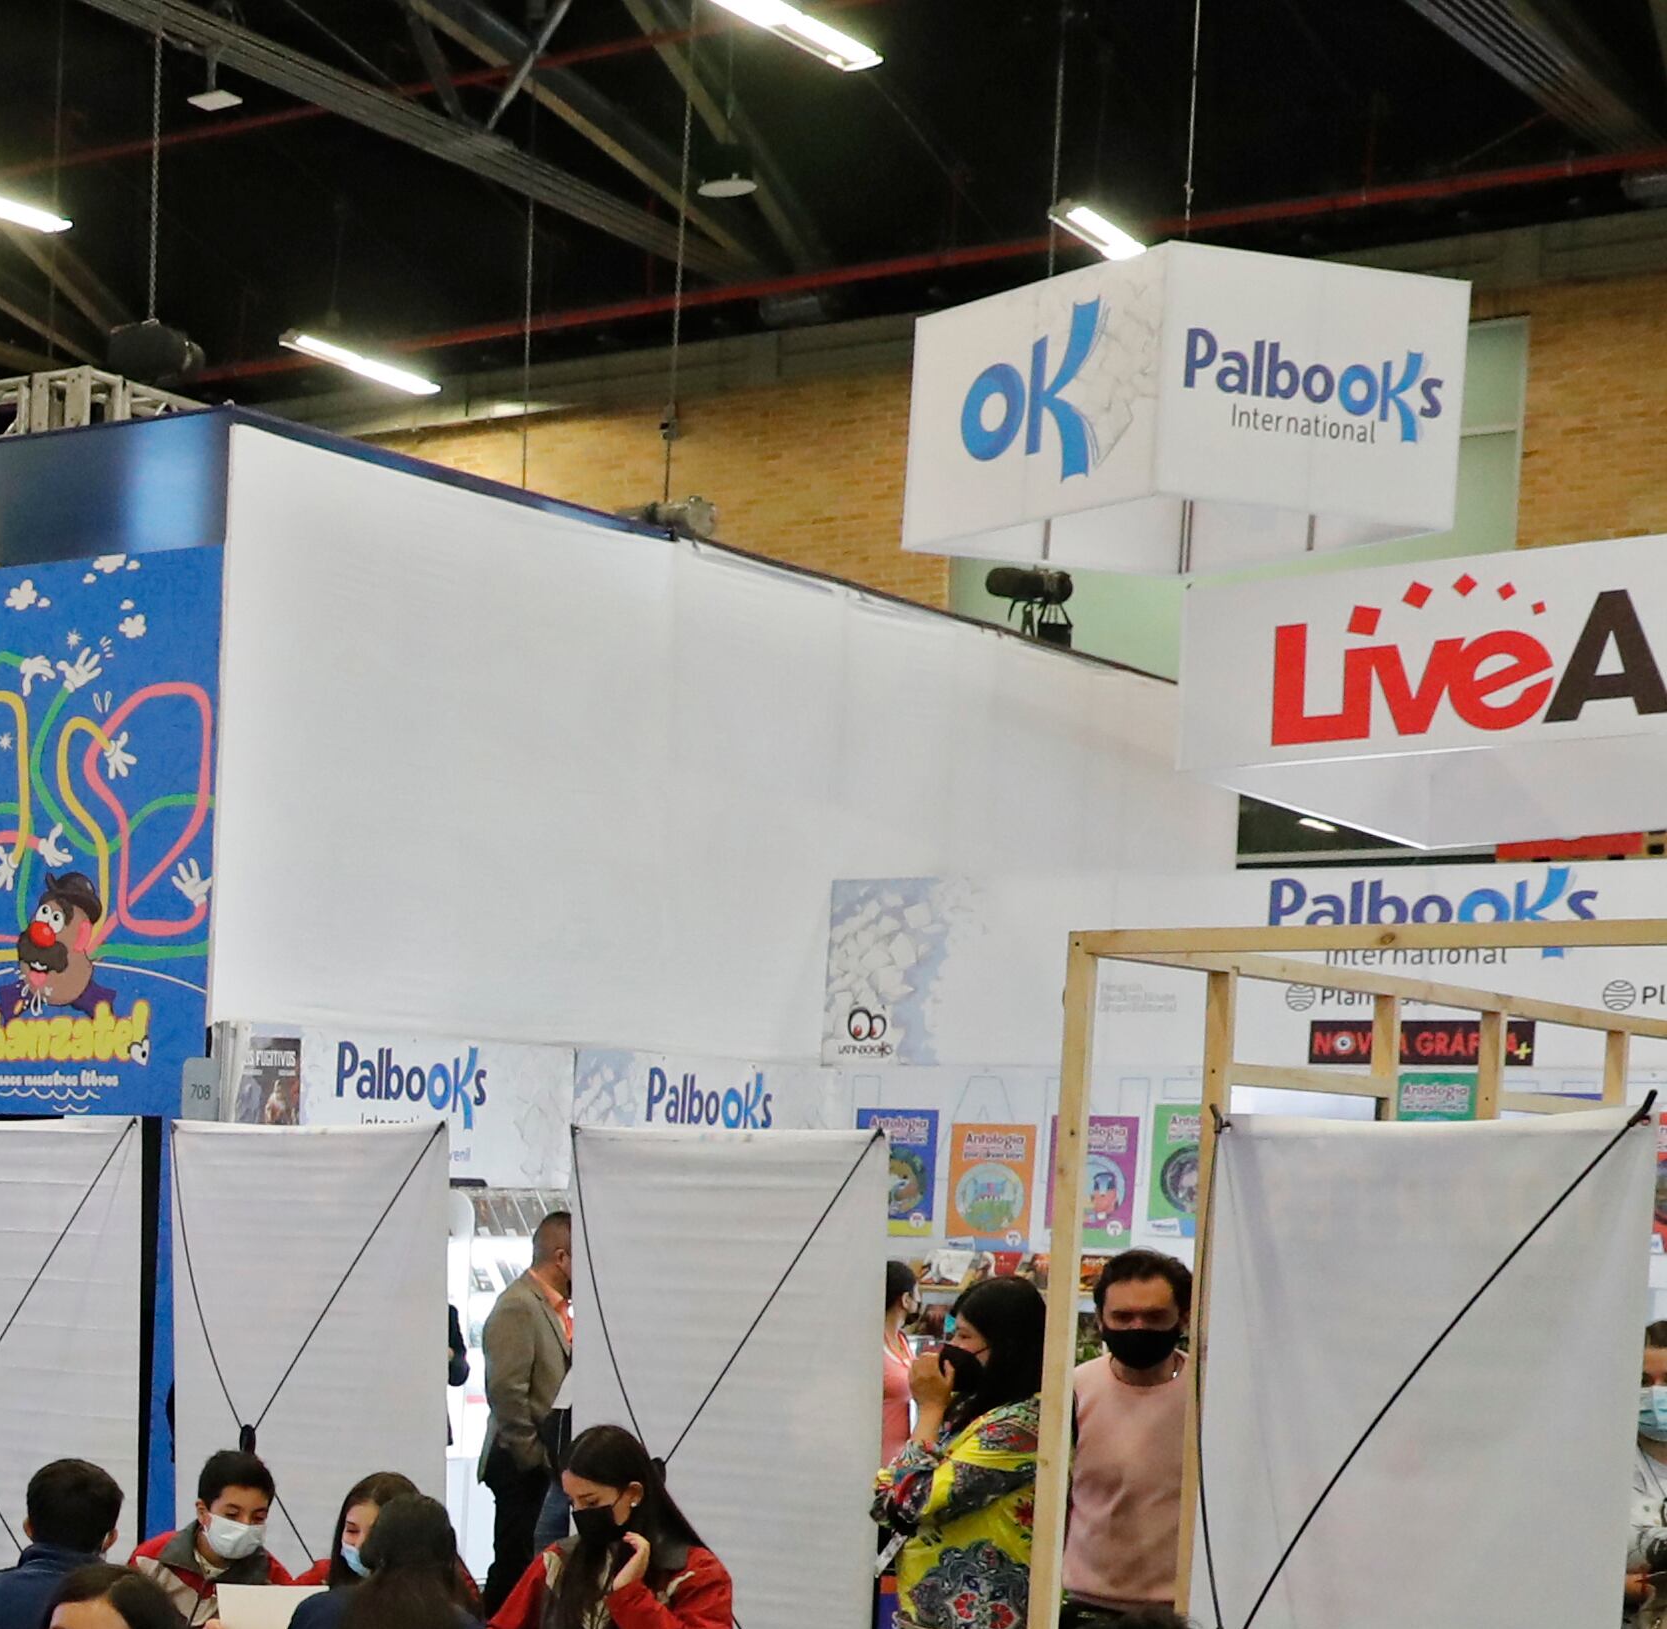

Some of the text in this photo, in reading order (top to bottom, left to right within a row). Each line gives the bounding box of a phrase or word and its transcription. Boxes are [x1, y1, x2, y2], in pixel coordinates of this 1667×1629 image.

[1230, 403, 1377, 444] International
[23, 1069, 79, 1087] nuestros
[79, 1068, 120, 1087] libros
[190, 1084, 211, 1100] 708
